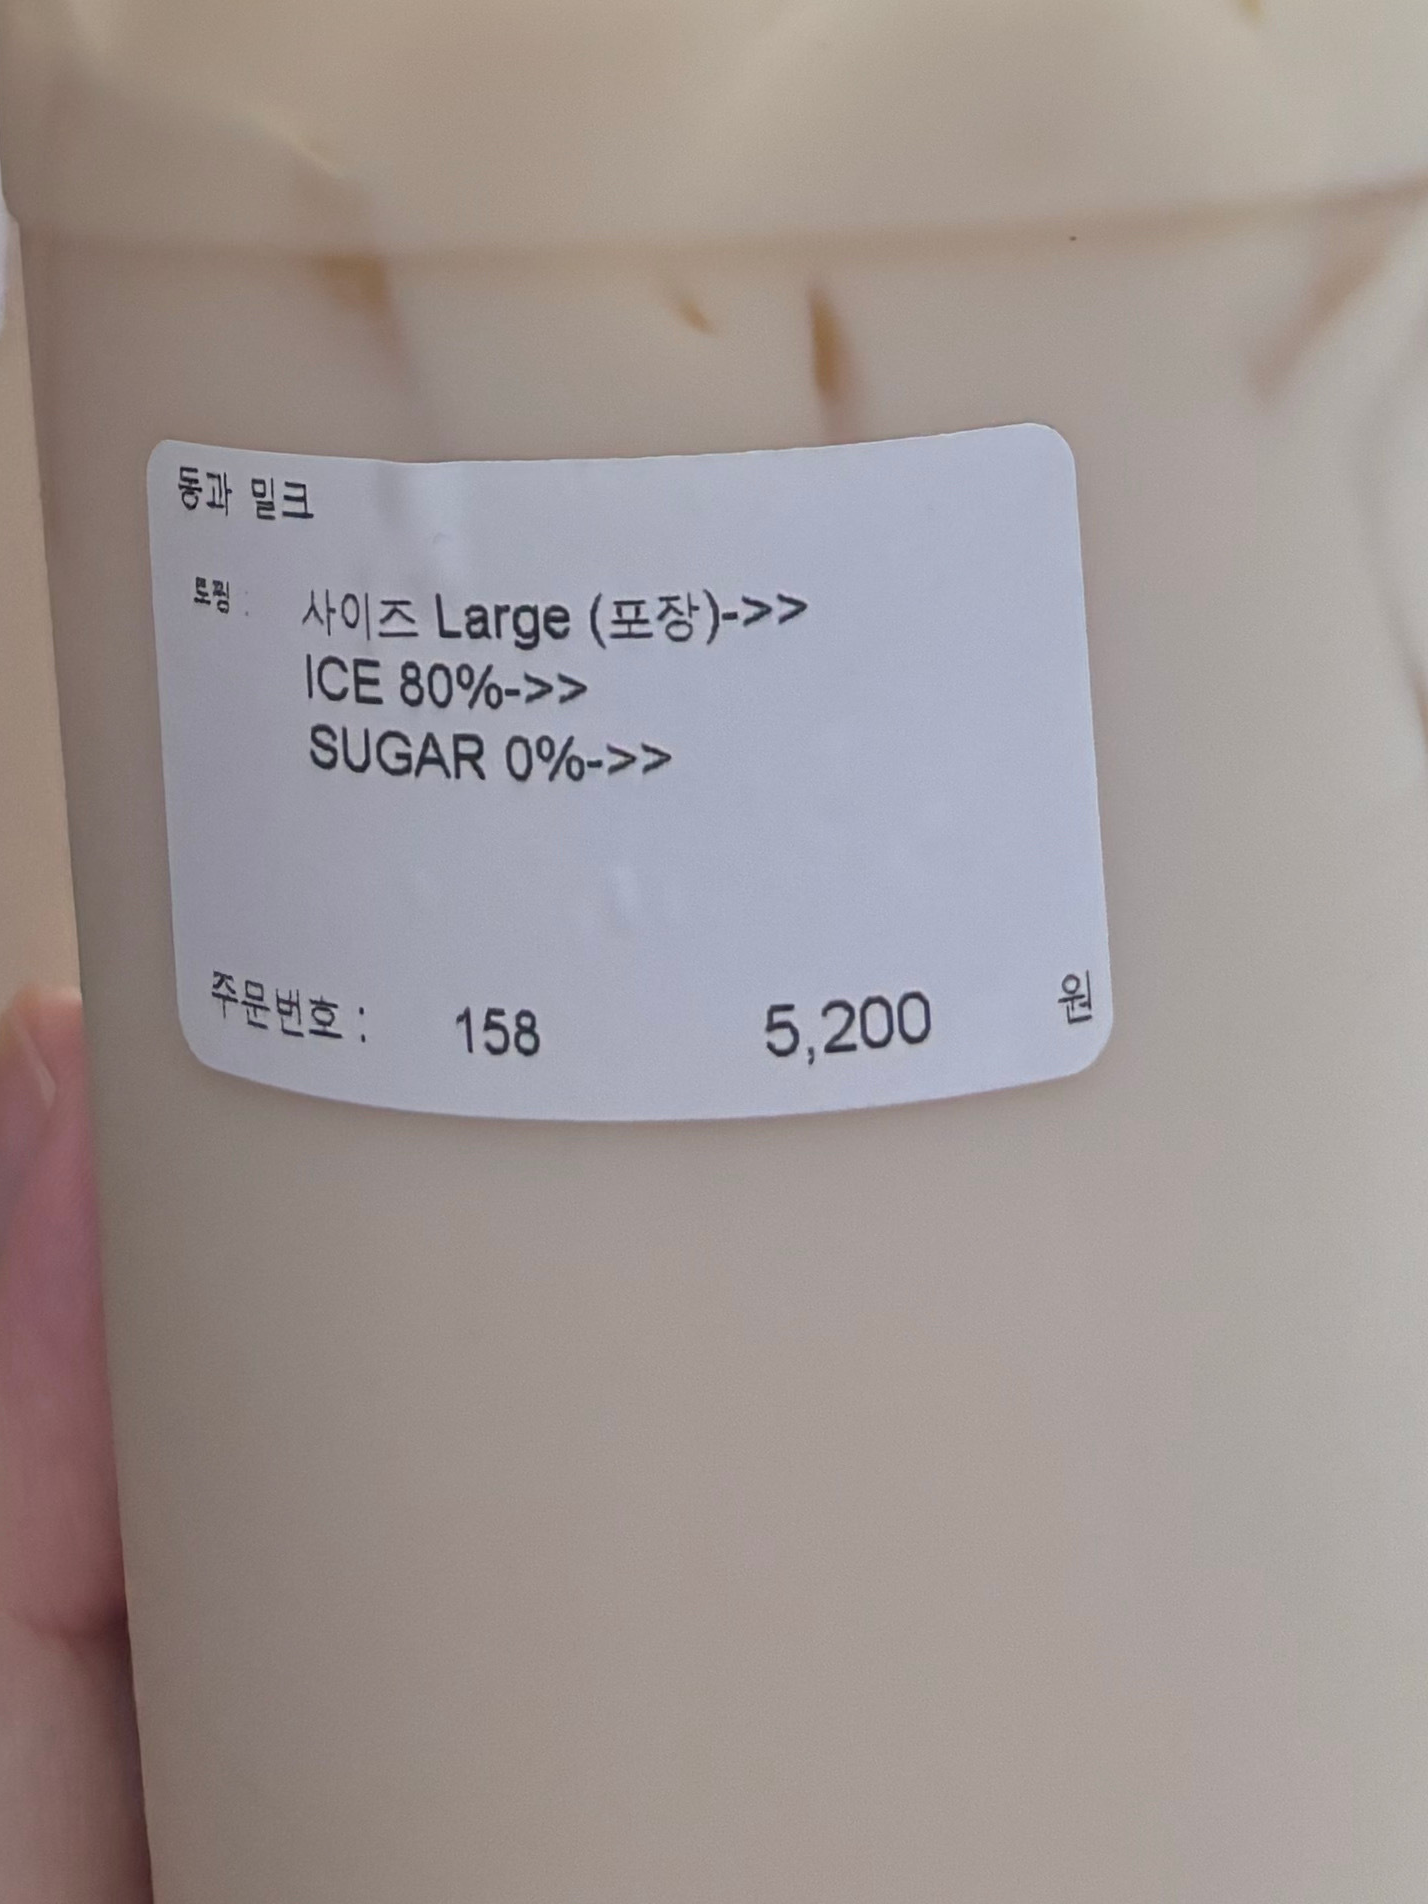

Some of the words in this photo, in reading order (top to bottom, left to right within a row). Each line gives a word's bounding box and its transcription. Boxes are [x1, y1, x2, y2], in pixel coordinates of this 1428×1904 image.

[177, 465, 235, 518] 동과
[250, 476, 316, 522] 밀크
[300, 587, 420, 642] 사이즈
[434, 592, 572, 652] Large
[304, 652, 384, 706] ICE
[308, 722, 487, 782] SUGAR
[1056, 968, 1094, 1027] 원
[454, 1004, 542, 1058] 158
[763, 989, 933, 1068] 5,200
